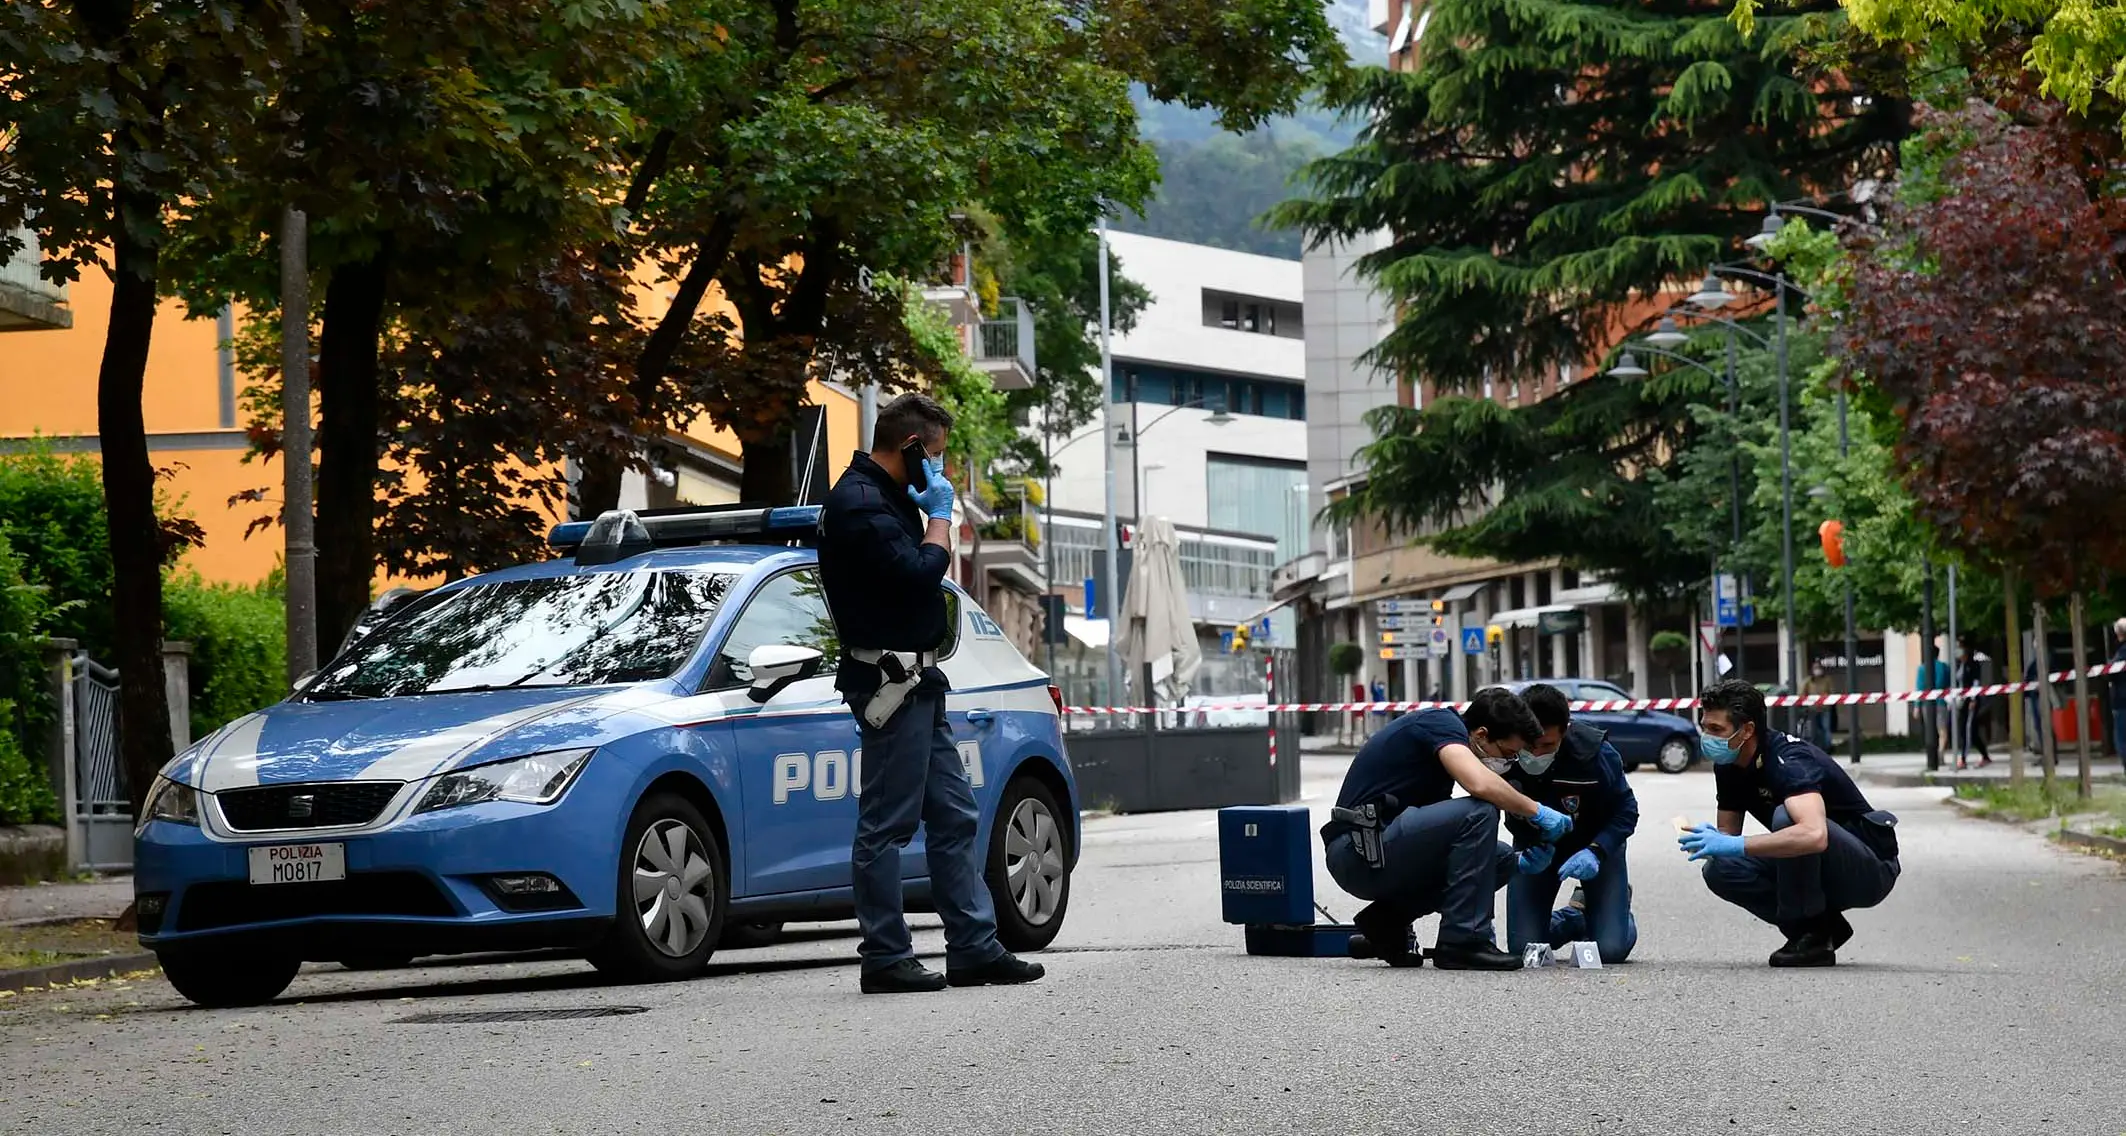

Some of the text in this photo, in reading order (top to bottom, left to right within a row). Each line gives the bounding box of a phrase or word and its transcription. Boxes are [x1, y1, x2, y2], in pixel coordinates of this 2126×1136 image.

[966, 611, 1001, 636] 115
[270, 846, 323, 860] POLIZIA
[273, 861, 321, 882] M0817
[1224, 879, 1282, 890] POLIZIA SCIENTIFICA
[1583, 949, 1594, 962] 6
